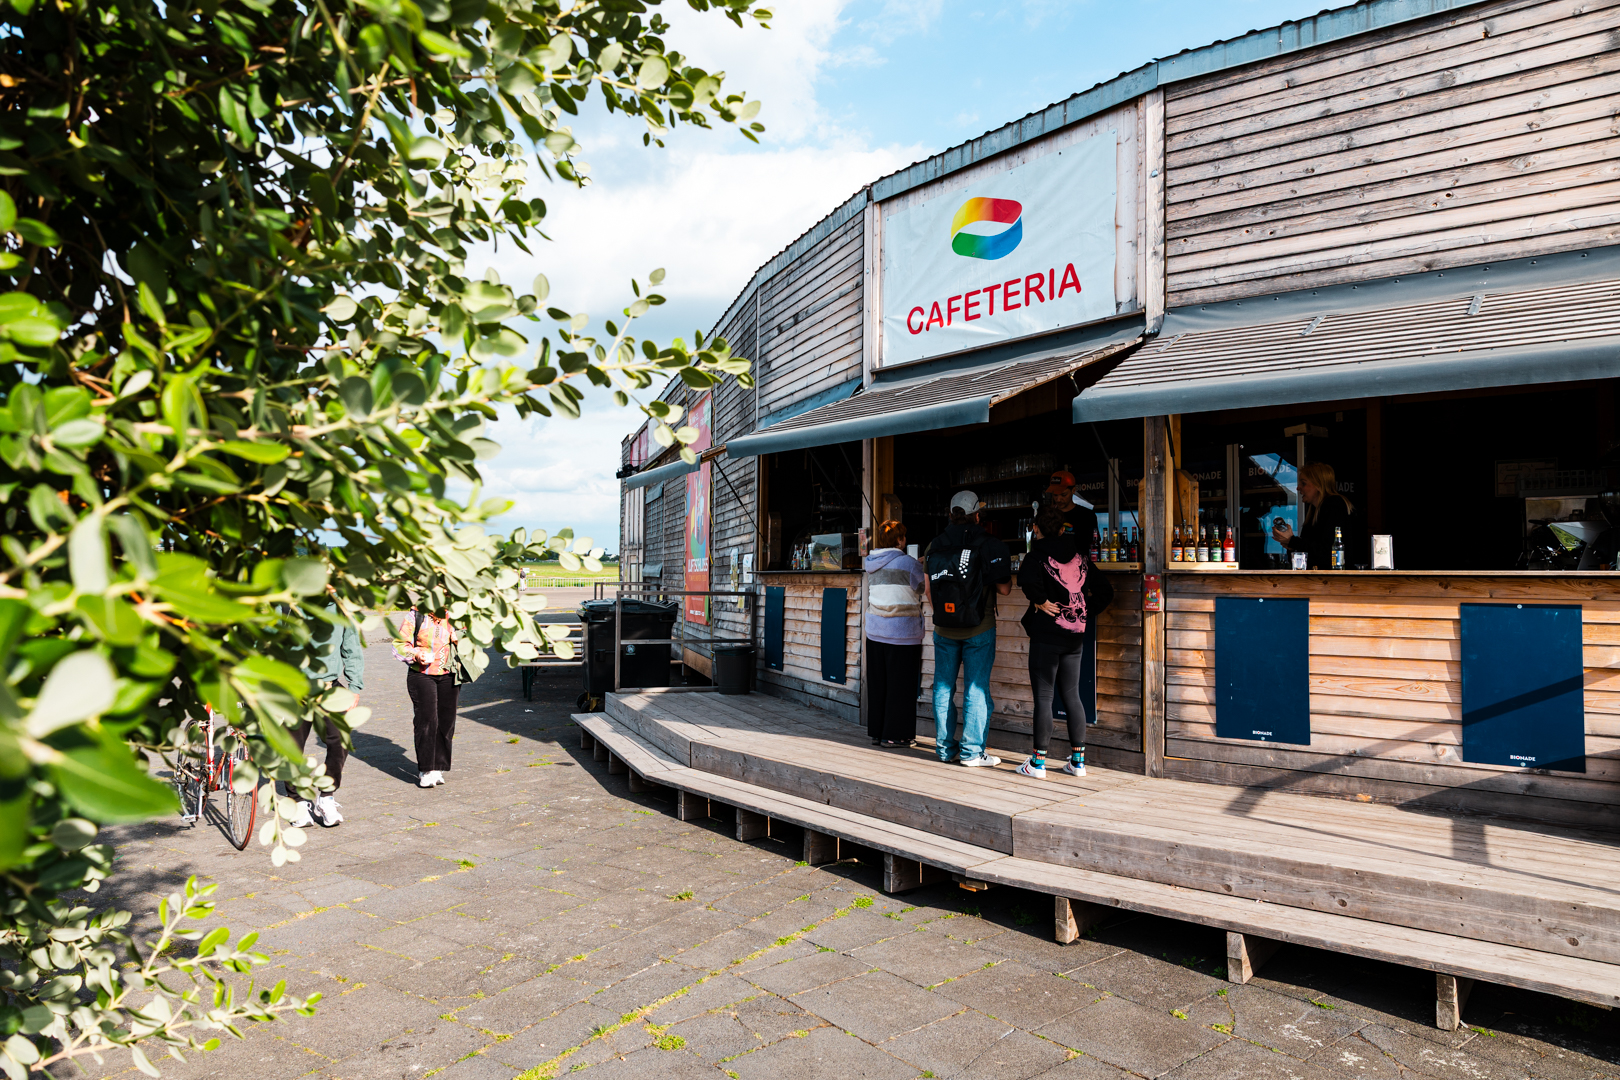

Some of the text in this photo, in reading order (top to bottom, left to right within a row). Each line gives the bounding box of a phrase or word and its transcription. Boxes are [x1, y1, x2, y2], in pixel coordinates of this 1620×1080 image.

[907, 263, 1082, 335] CAFETERIA
[1192, 470, 1222, 481] ONADE
[1248, 464, 1291, 477] BIONADE
[1509, 754, 1536, 762] BIONADE
